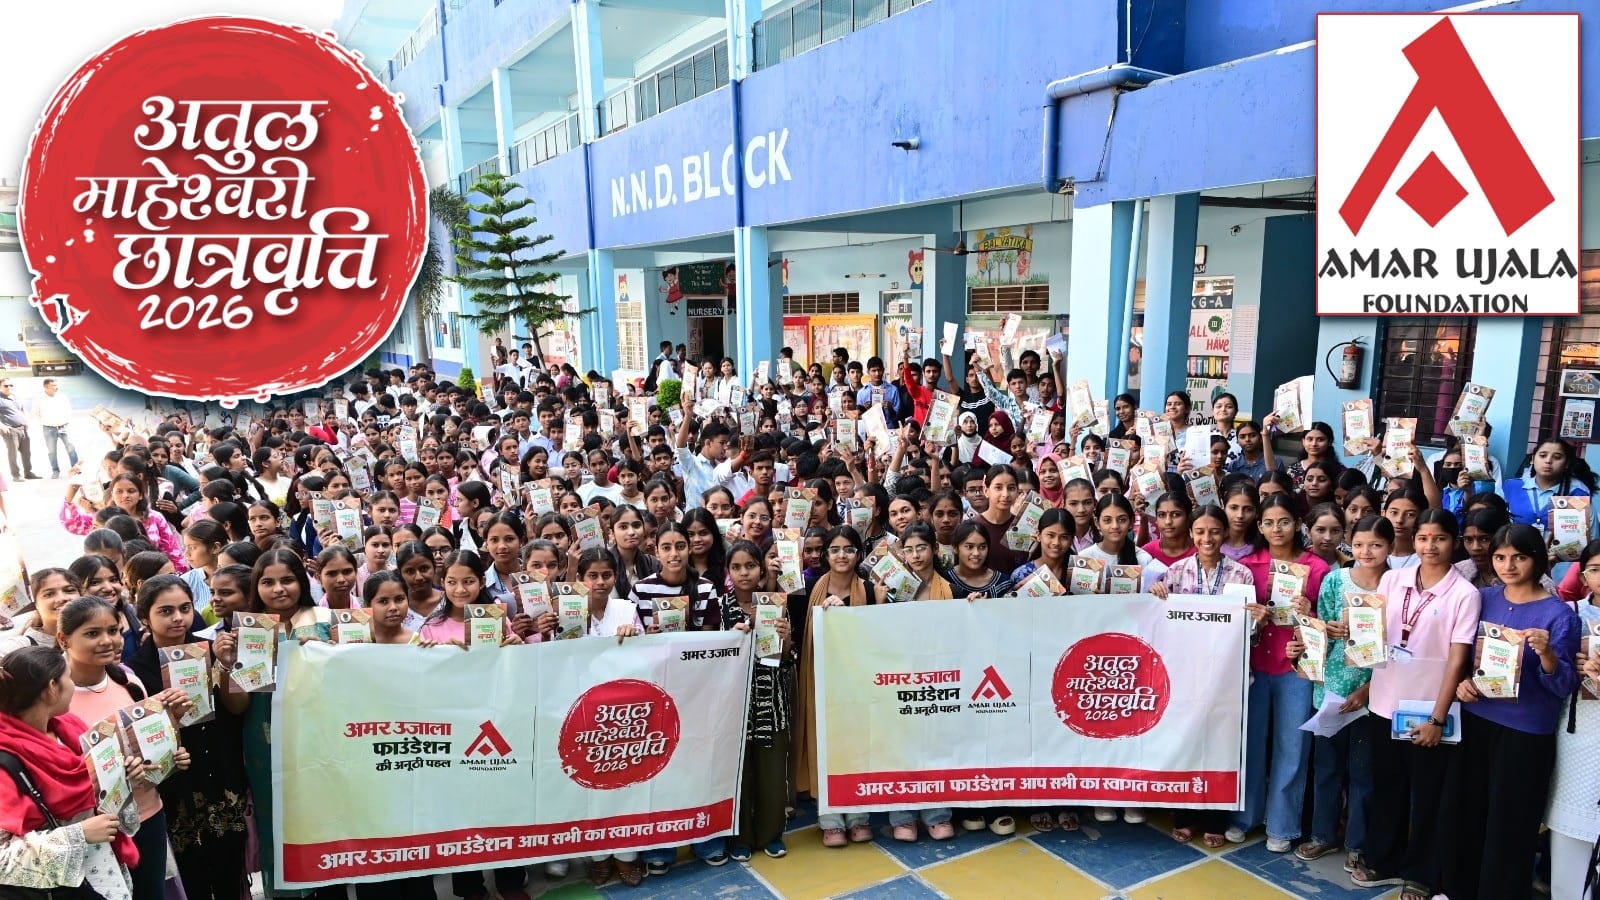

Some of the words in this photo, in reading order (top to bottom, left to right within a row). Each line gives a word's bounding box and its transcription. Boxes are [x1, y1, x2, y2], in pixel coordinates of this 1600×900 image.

[611, 163, 678, 218] N.N.D.
[688, 306, 725, 316] NURSERY
[1189, 325, 1208, 338] ALL
[1568, 383, 1595, 393] STOP
[1166, 610, 1195, 622] अमर
[1195, 611, 1232, 624] उजाला
[680, 649, 707, 661] अमर
[707, 647, 741, 659] उजाला
[1084, 654, 1141, 676] अतुल
[873, 672, 912, 686] अमर
[913, 669, 961, 685] उजाला
[1066, 672, 1137, 693] माहेश्वरी
[897, 685, 961, 703] फाउंडेशन
[1077, 686, 1159, 718] छात्रवृत्ति
[594, 701, 654, 724] अतुल
[899, 704, 913, 715] की
[914, 703, 939, 717] अनूठी
[939, 704, 961, 713] पहल
[992, 702, 1016, 710] UJALA
[1085, 710, 1119, 721] 2026
[343, 721, 392, 738] अमर
[392, 721, 452, 737] उजाला
[575, 719, 648, 746] माहेश्वरी
[372, 736, 452, 756] फाउंडेशन
[585, 731, 669, 765] छात्रवृत्ति
[375, 759, 391, 772] की
[394, 757, 424, 772] अनूठी
[425, 759, 451, 769] पहल
[459, 758, 487, 766] AMAR
[489, 758, 518, 767] UJALA
[593, 760, 629, 774] 2026
[855, 781, 895, 797] अमर
[895, 780, 945, 795] उजाला
[949, 774, 1016, 792] फाउंडेशन
[1019, 777, 1047, 790] आप
[1050, 773, 1079, 790] सभी
[1080, 777, 1101, 790] का
[1102, 777, 1149, 793] स्वागत
[1150, 780, 1190, 794] करता
[317, 850, 368, 870] अमर
[368, 845, 431, 864] उजाला
[436, 833, 515, 857] फाउंडेशन
[517, 834, 549, 848] आप
[552, 826, 582, 844] सभी
[584, 828, 606, 841] का
[608, 823, 654, 839] स्वागत
[656, 817, 695, 833] करता
